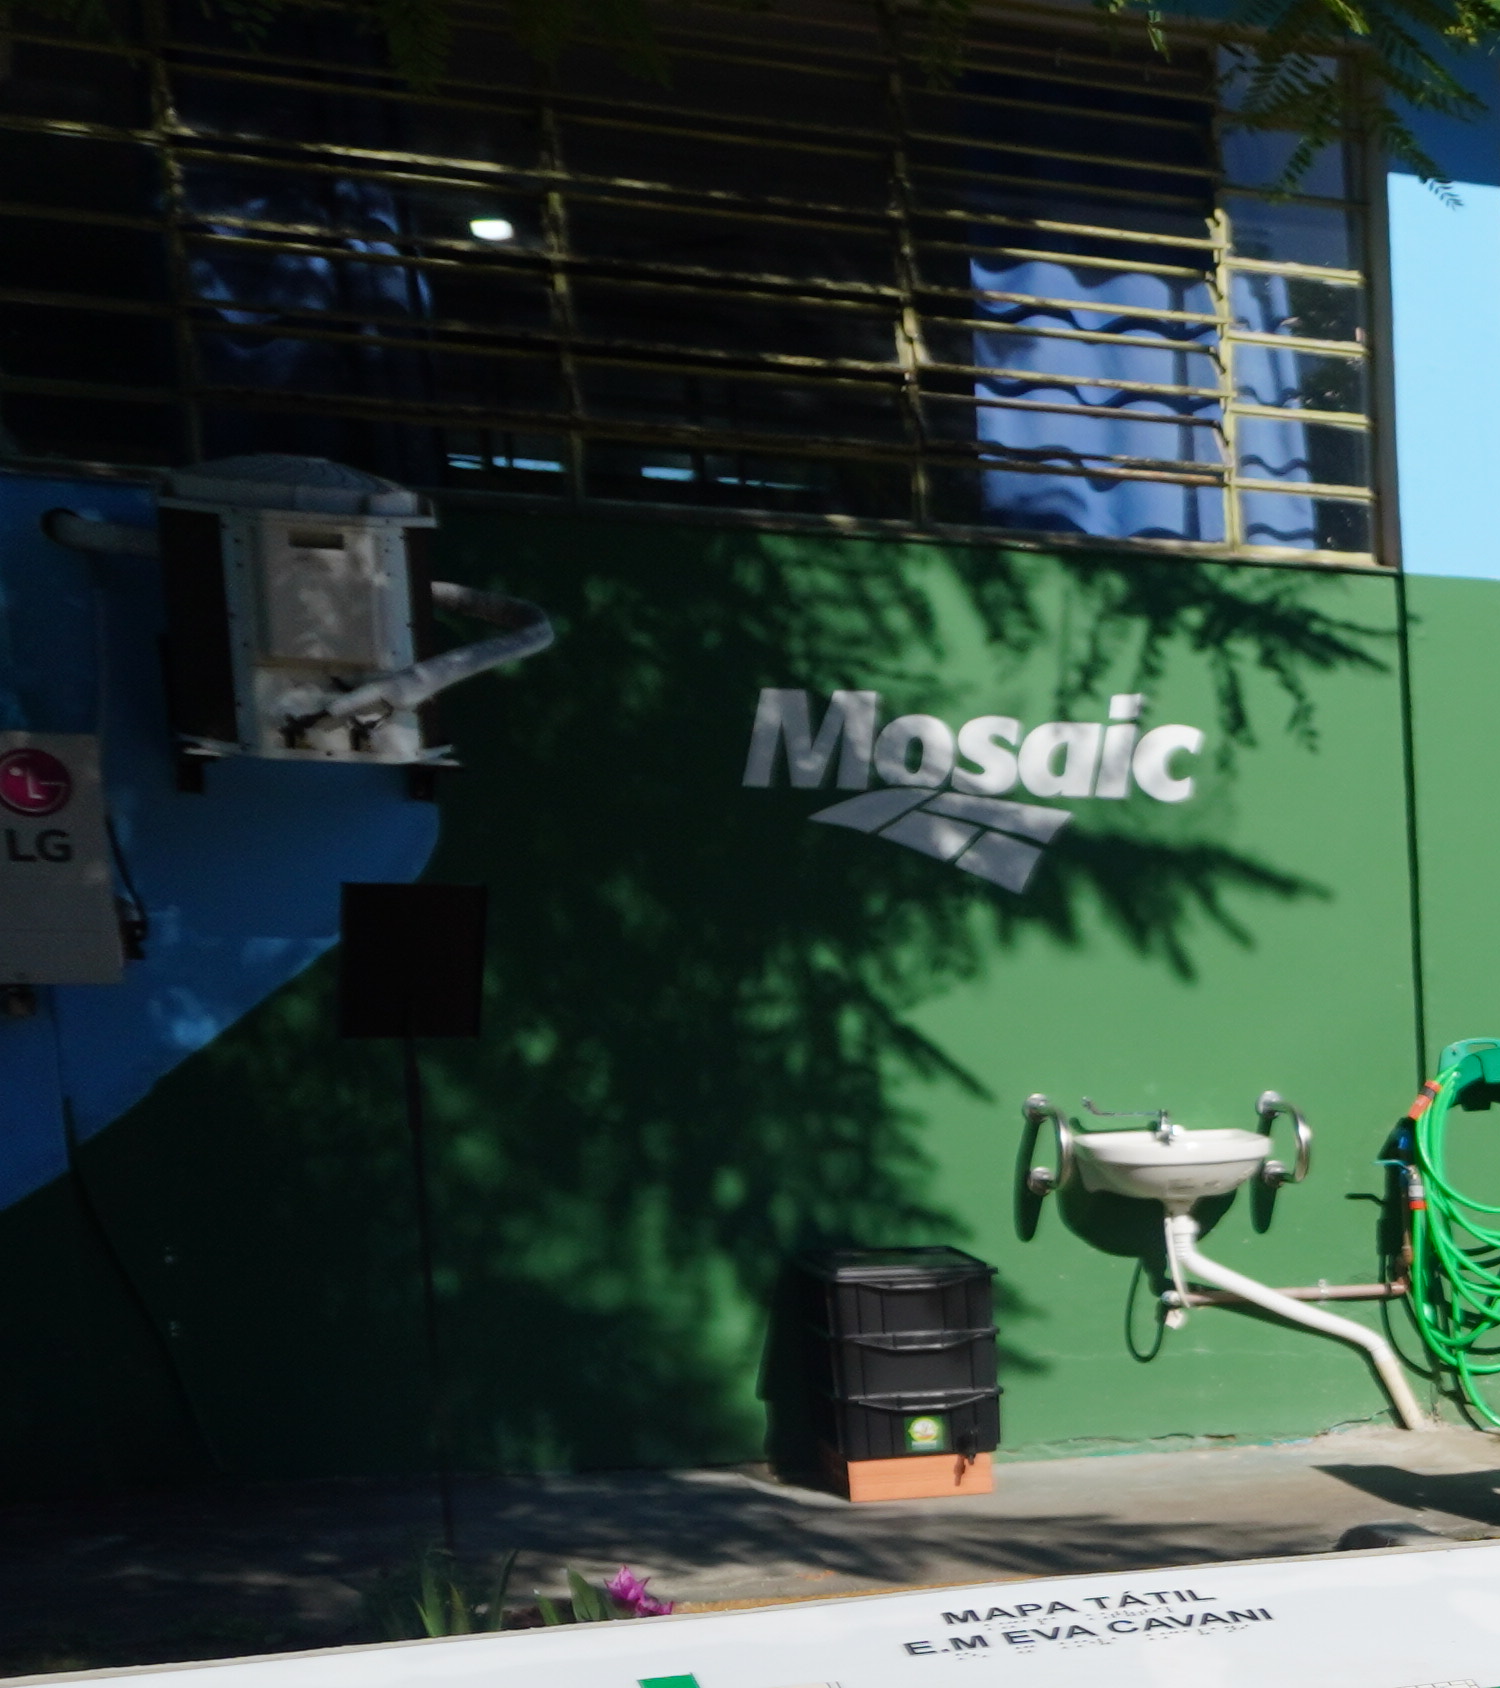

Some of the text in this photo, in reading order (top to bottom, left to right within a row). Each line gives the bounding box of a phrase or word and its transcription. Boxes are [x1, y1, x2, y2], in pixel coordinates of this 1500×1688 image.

[741, 687, 1203, 802] Mosaic
[5, 828, 72, 863] LG
[941, 1589, 1217, 1626] MAPA TÁTIL
[902, 1607, 1274, 1656] E.M EVA CAVANI
